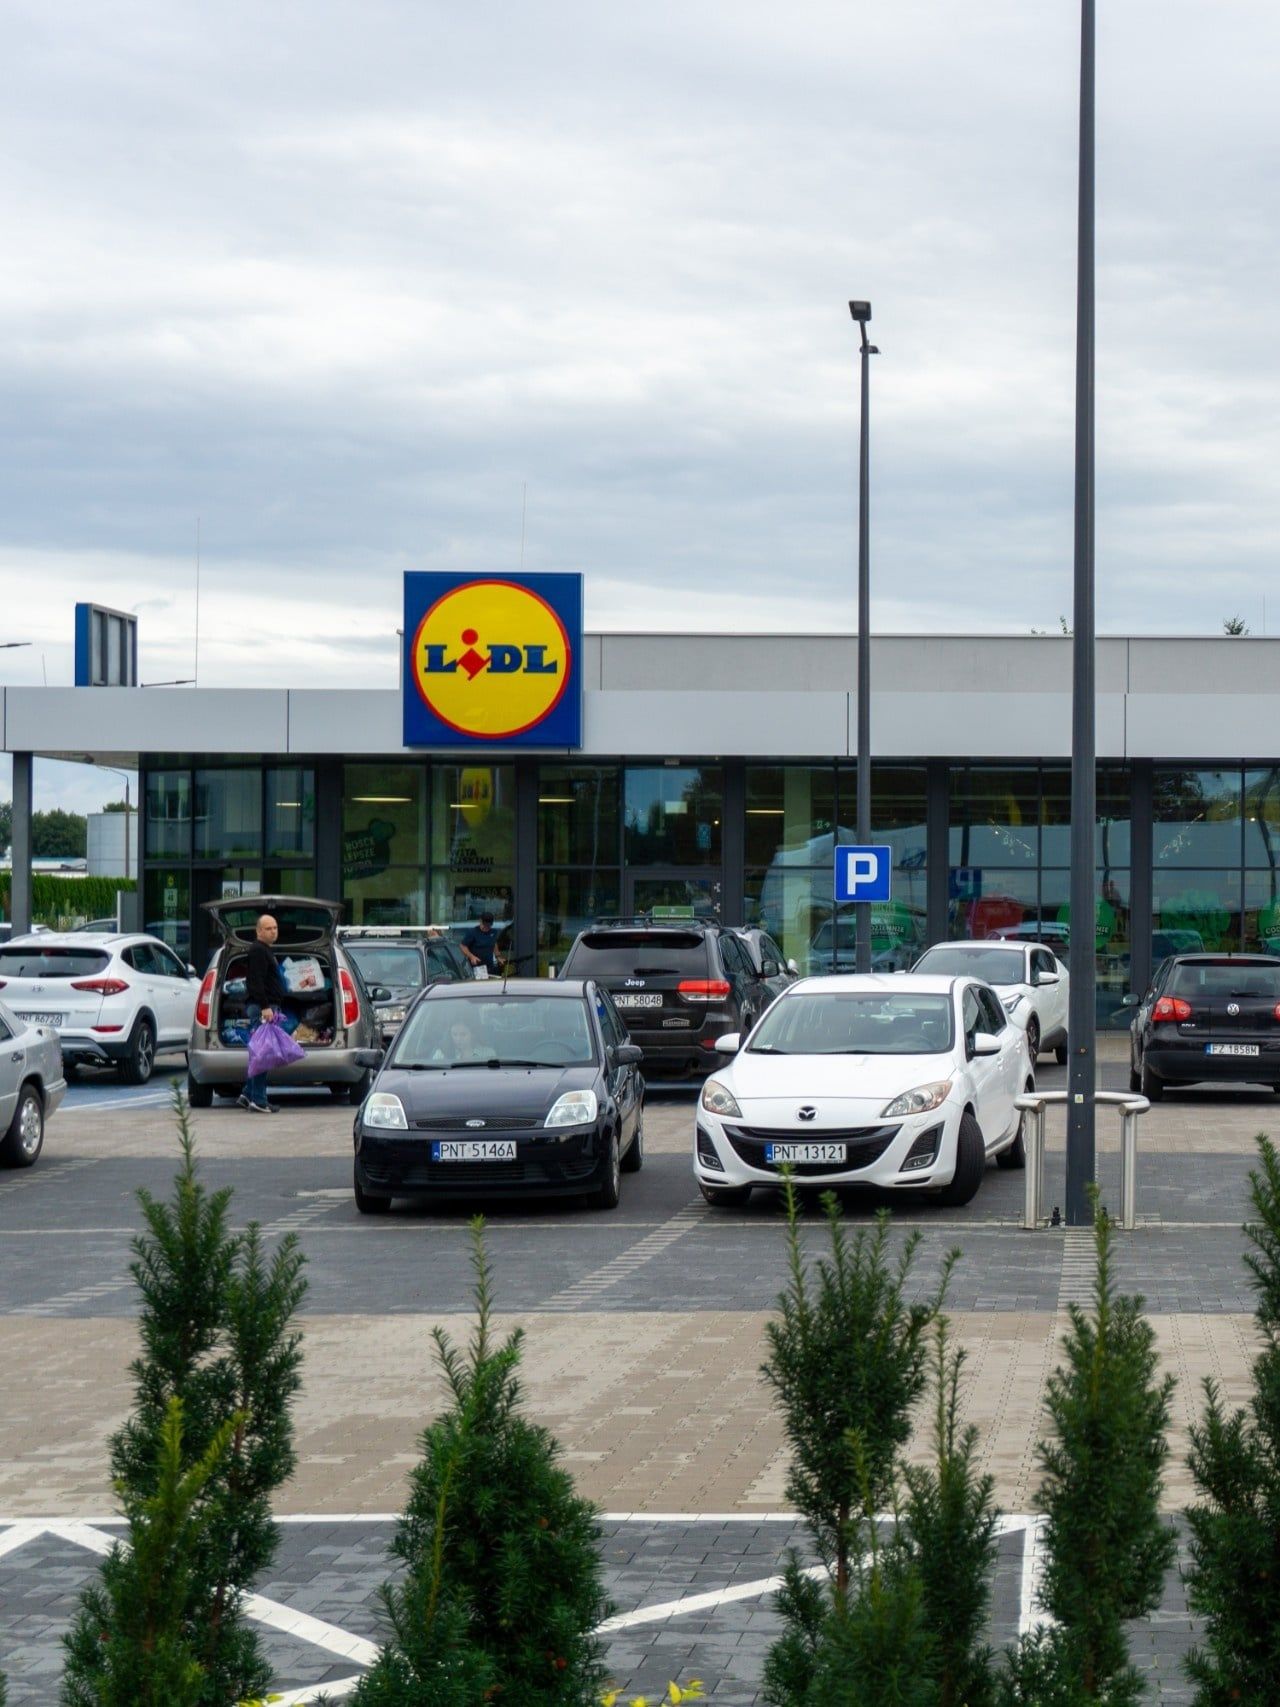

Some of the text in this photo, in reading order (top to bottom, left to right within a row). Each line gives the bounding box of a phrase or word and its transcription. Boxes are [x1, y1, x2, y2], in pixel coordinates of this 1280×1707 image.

[847, 853, 878, 895] P
[625, 979, 645, 987] Jeep
[440, 1143, 514, 1158] PNT 5146A
[773, 1145, 843, 1159] PNT 13121
